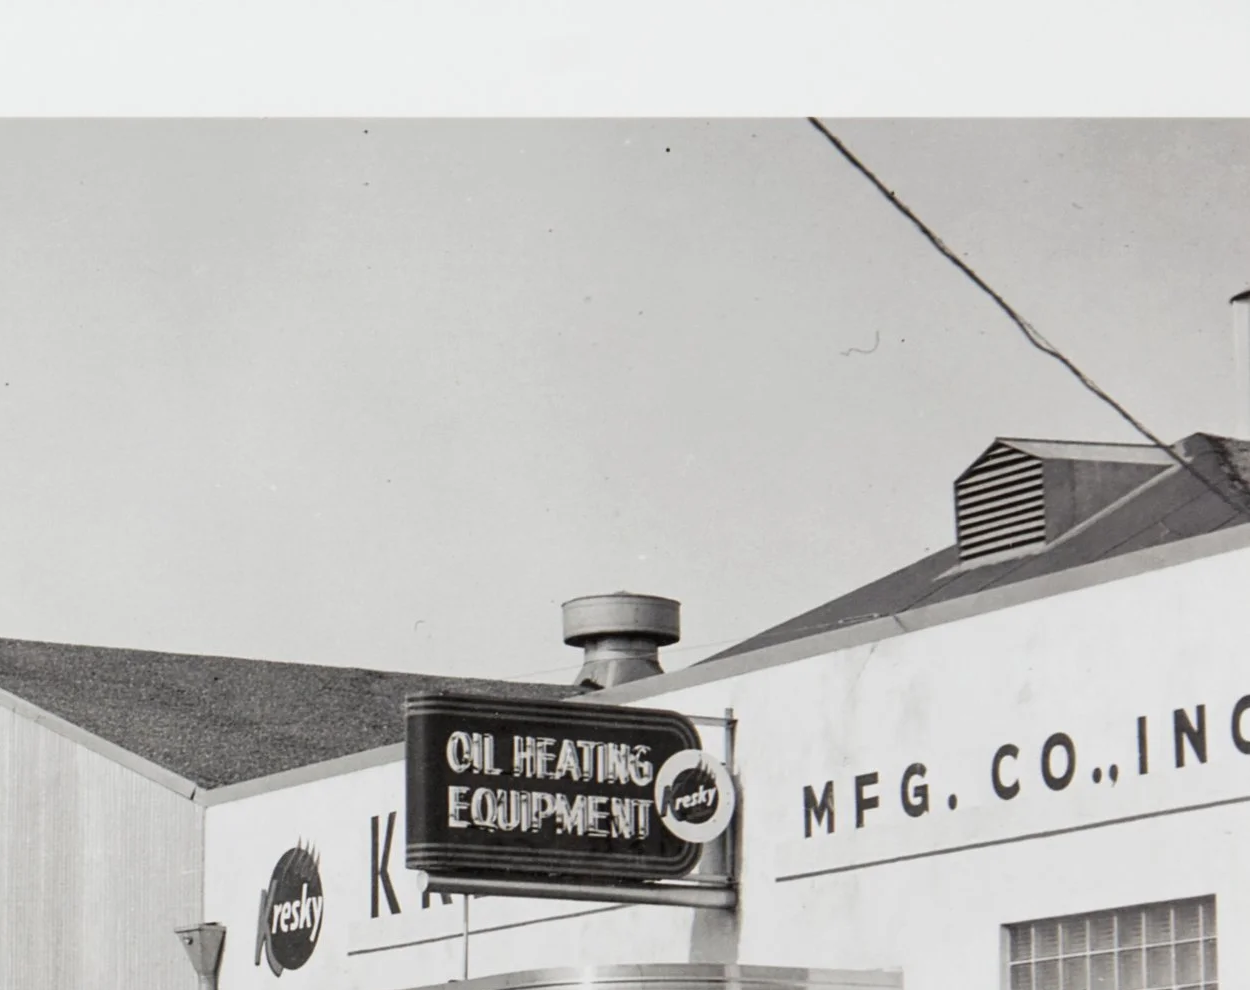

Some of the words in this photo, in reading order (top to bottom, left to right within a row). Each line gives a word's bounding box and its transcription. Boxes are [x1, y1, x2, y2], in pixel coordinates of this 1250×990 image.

[446, 731, 503, 774] OIL
[513, 735, 653, 787] HEATING
[447, 785, 654, 840] EQUIPMENT
[660, 780, 716, 822] Kresky
[803, 762, 957, 839] MFG.
[254, 880, 323, 978] Kresky
